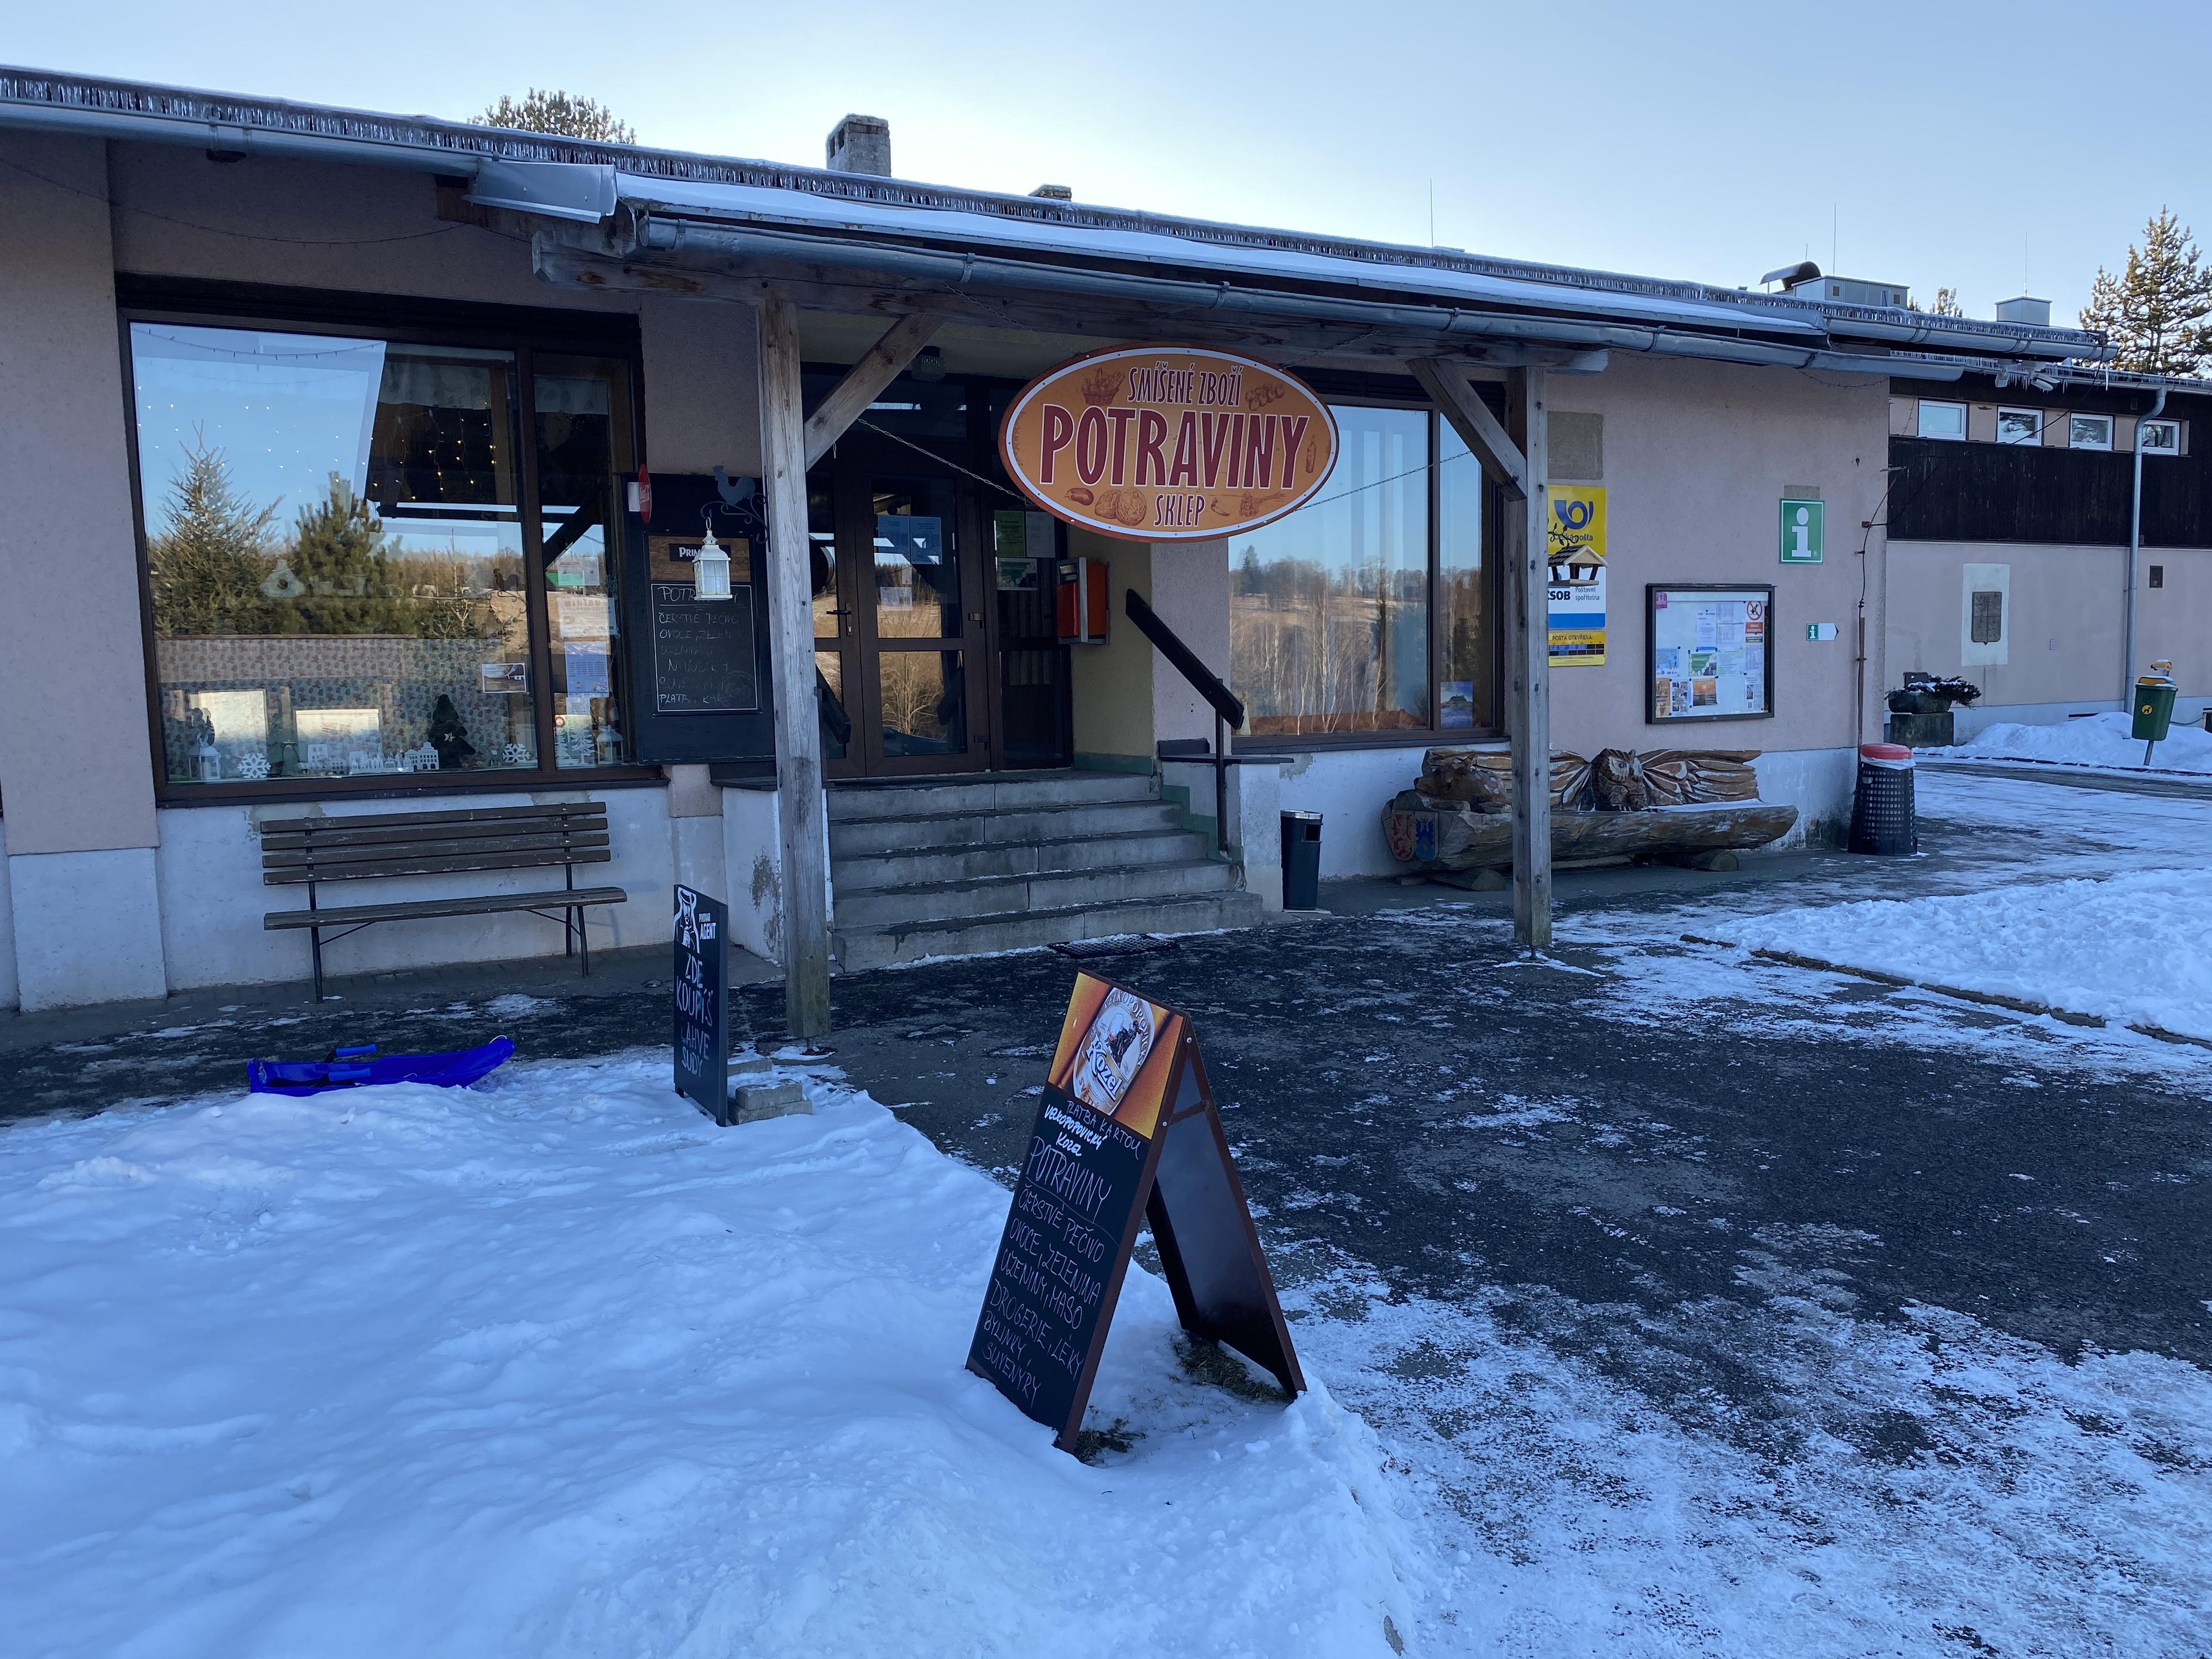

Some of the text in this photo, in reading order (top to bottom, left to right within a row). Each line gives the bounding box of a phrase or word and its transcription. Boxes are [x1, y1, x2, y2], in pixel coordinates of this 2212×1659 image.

[1127, 361, 1244, 408] SMÍŠENÉ ZBOŽÍ
[1040, 403, 1310, 490] POTRAVINY
[1154, 494, 1206, 527] SKLEP
[1548, 590, 1571, 601] SOB
[1575, 593, 1600, 602] spořitelna
[700, 922, 716, 940] AGENT
[685, 952, 703, 989] ZDE
[681, 1046, 703, 1078] SUDY
[1086, 1034, 1123, 1102] Kozel
[1067, 1100, 1141, 1161] PLATBA KARTOU
[1026, 1136, 1113, 1224] POTRAVINY
[1019, 1183, 1105, 1262] ČERSTVÉ PEČIVO
[1048, 1285, 1083, 1329] MASO
[1051, 1333, 1085, 1381] LÉKY
